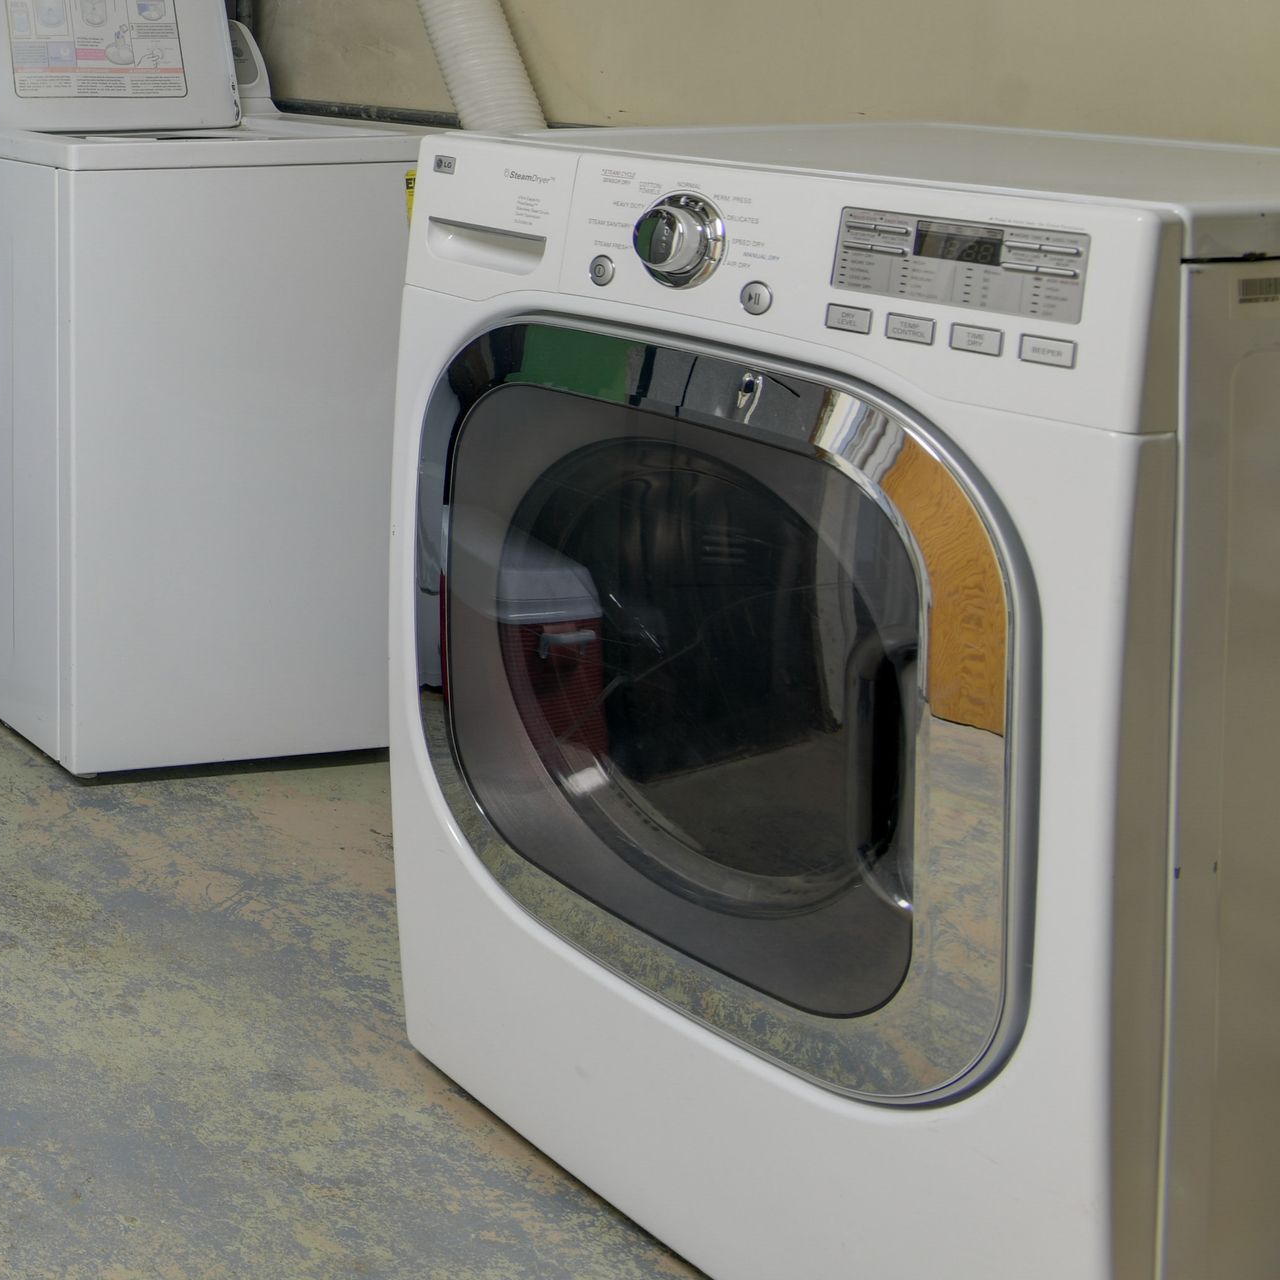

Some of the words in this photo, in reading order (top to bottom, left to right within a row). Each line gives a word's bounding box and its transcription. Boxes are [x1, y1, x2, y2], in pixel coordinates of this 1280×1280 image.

[443, 161, 452, 169] LG
[837, 319, 857, 327] LEVEL
[892, 327, 926, 338] CONTROL
[967, 332, 985, 340] TIME
[967, 339, 983, 347] DRY
[1032, 346, 1062, 357] BEEPER
